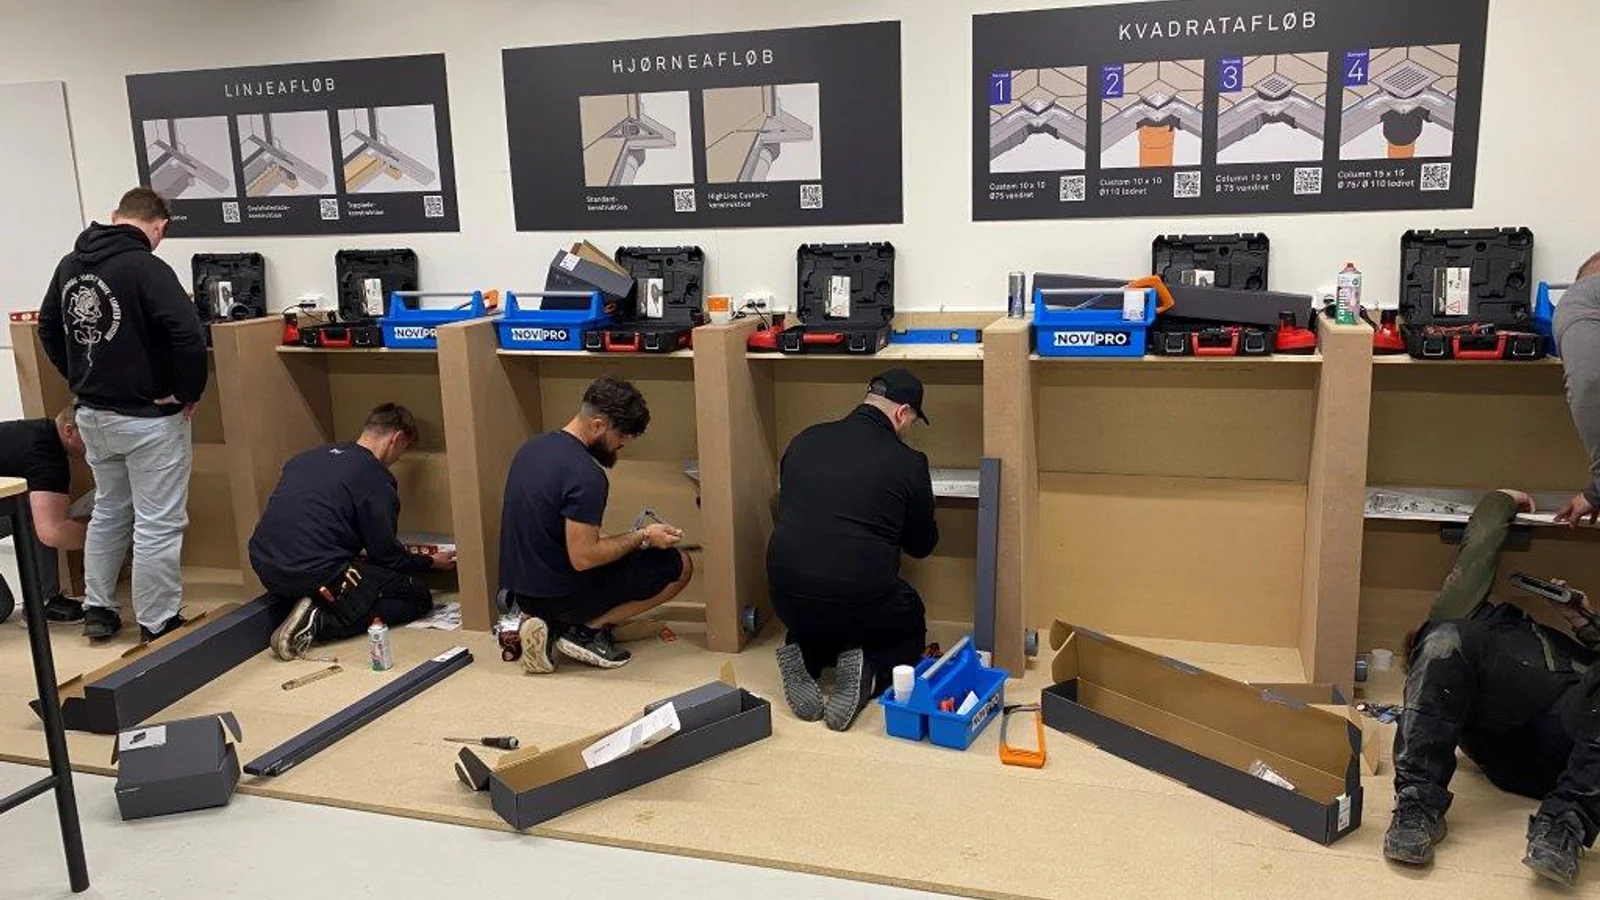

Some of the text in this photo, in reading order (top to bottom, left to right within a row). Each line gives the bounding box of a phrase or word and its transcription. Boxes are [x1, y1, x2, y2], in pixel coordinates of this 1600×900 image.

[1118, 11, 1316, 41] KVADRATAFLØB
[612, 49, 774, 73] HJØRNEAFLØB
[1223, 65, 1238, 89] 3
[1347, 59, 1364, 82] 4
[224, 78, 335, 98] LINJEAFLØB
[995, 80, 1003, 101] 1
[1106, 73, 1119, 95] 2
[1100, 178, 1131, 186] Custom
[1133, 177, 1143, 185] 10
[1152, 176, 1162, 184] 10
[1215, 174, 1249, 183] Column
[1271, 173, 1281, 181] 10
[1337, 170, 1372, 179] Column
[1387, 179, 1415, 188] lodret
[396, 328, 437, 338] NOVIPR
[514, 329, 567, 340] NOVIPRO
[1057, 332, 1127, 345] NOVIPRO
